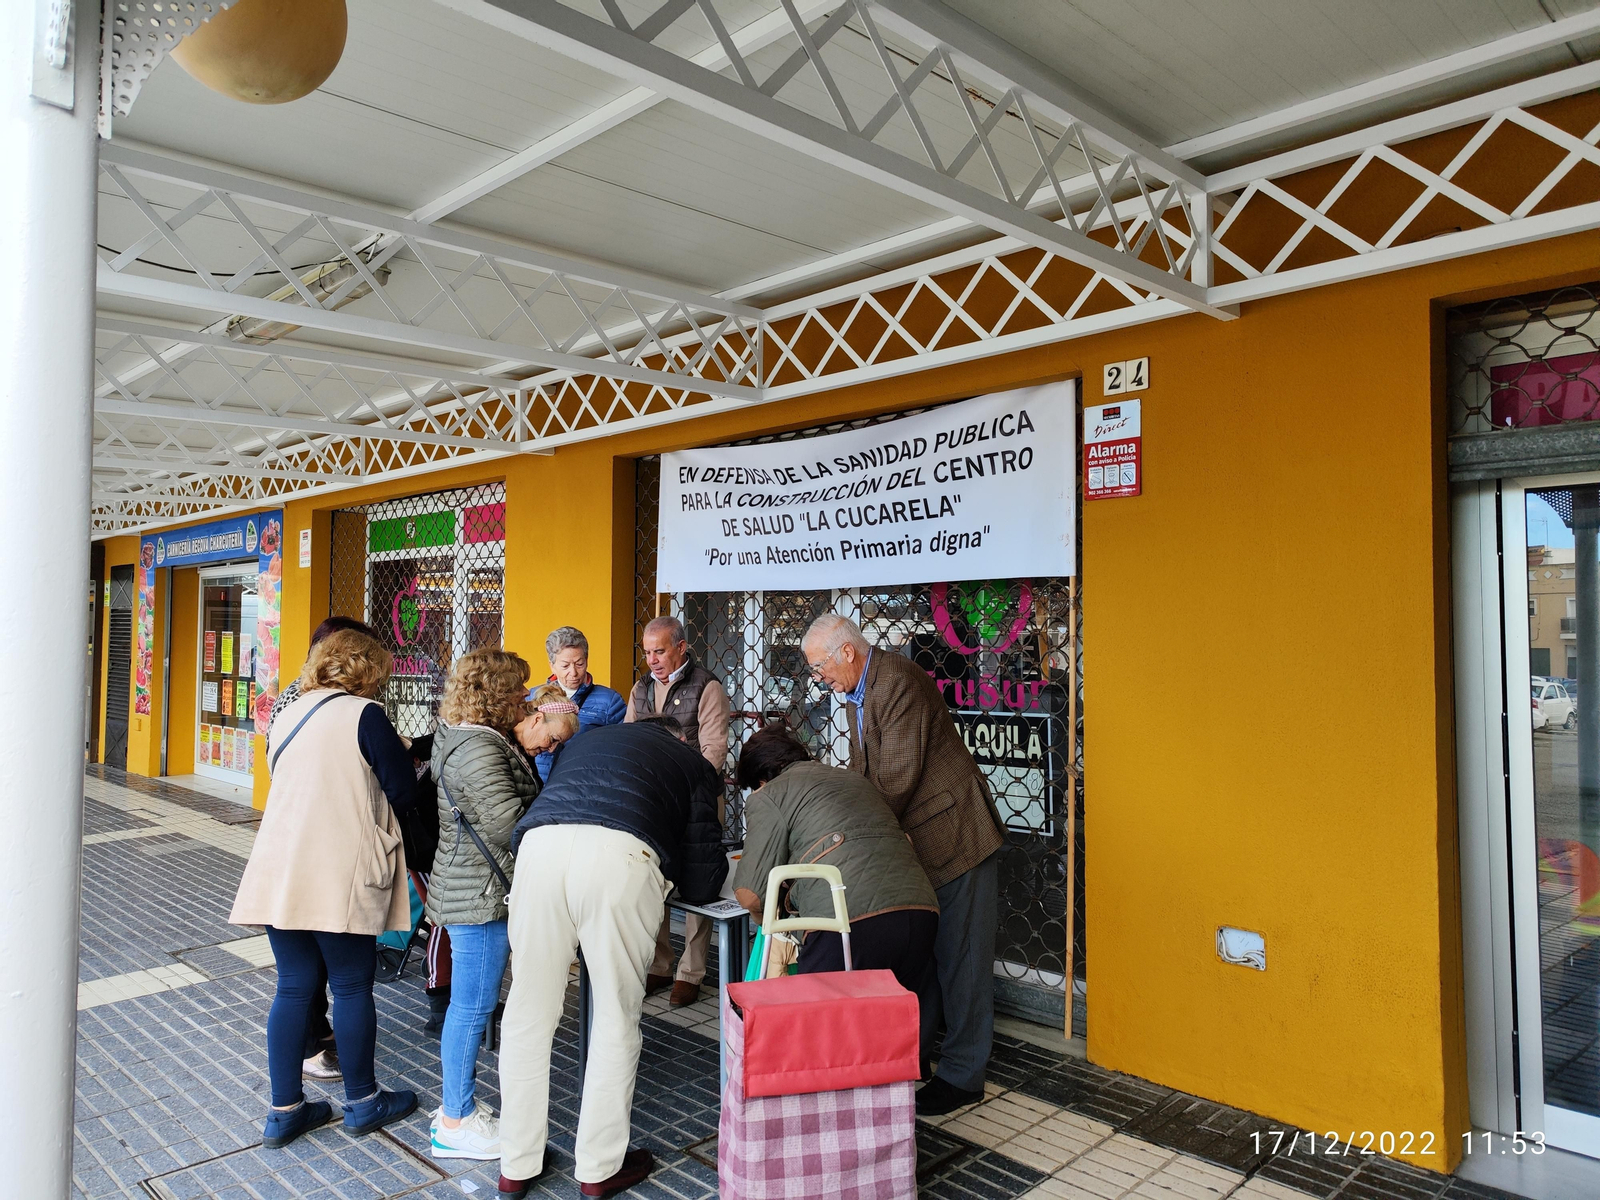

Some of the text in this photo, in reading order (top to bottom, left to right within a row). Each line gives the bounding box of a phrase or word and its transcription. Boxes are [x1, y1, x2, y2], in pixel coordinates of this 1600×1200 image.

[1107, 360, 1144, 391] 24
[1093, 417, 1132, 439] Direct
[679, 410, 1035, 486] EN DEFENSA DE LA SANIDAD PUBLICA
[1088, 442, 1137, 459] Alarma
[1098, 457, 1113, 465] aviso
[681, 446, 1034, 511] PARA LA CONSTRUCCIÓN DEL CENTRO
[721, 494, 962, 537] DE SALUD "LA CUCARELA"
[704, 525, 991, 566] "Por una Atención Primaria digna"
[954, 723, 1042, 760] LQUILA
